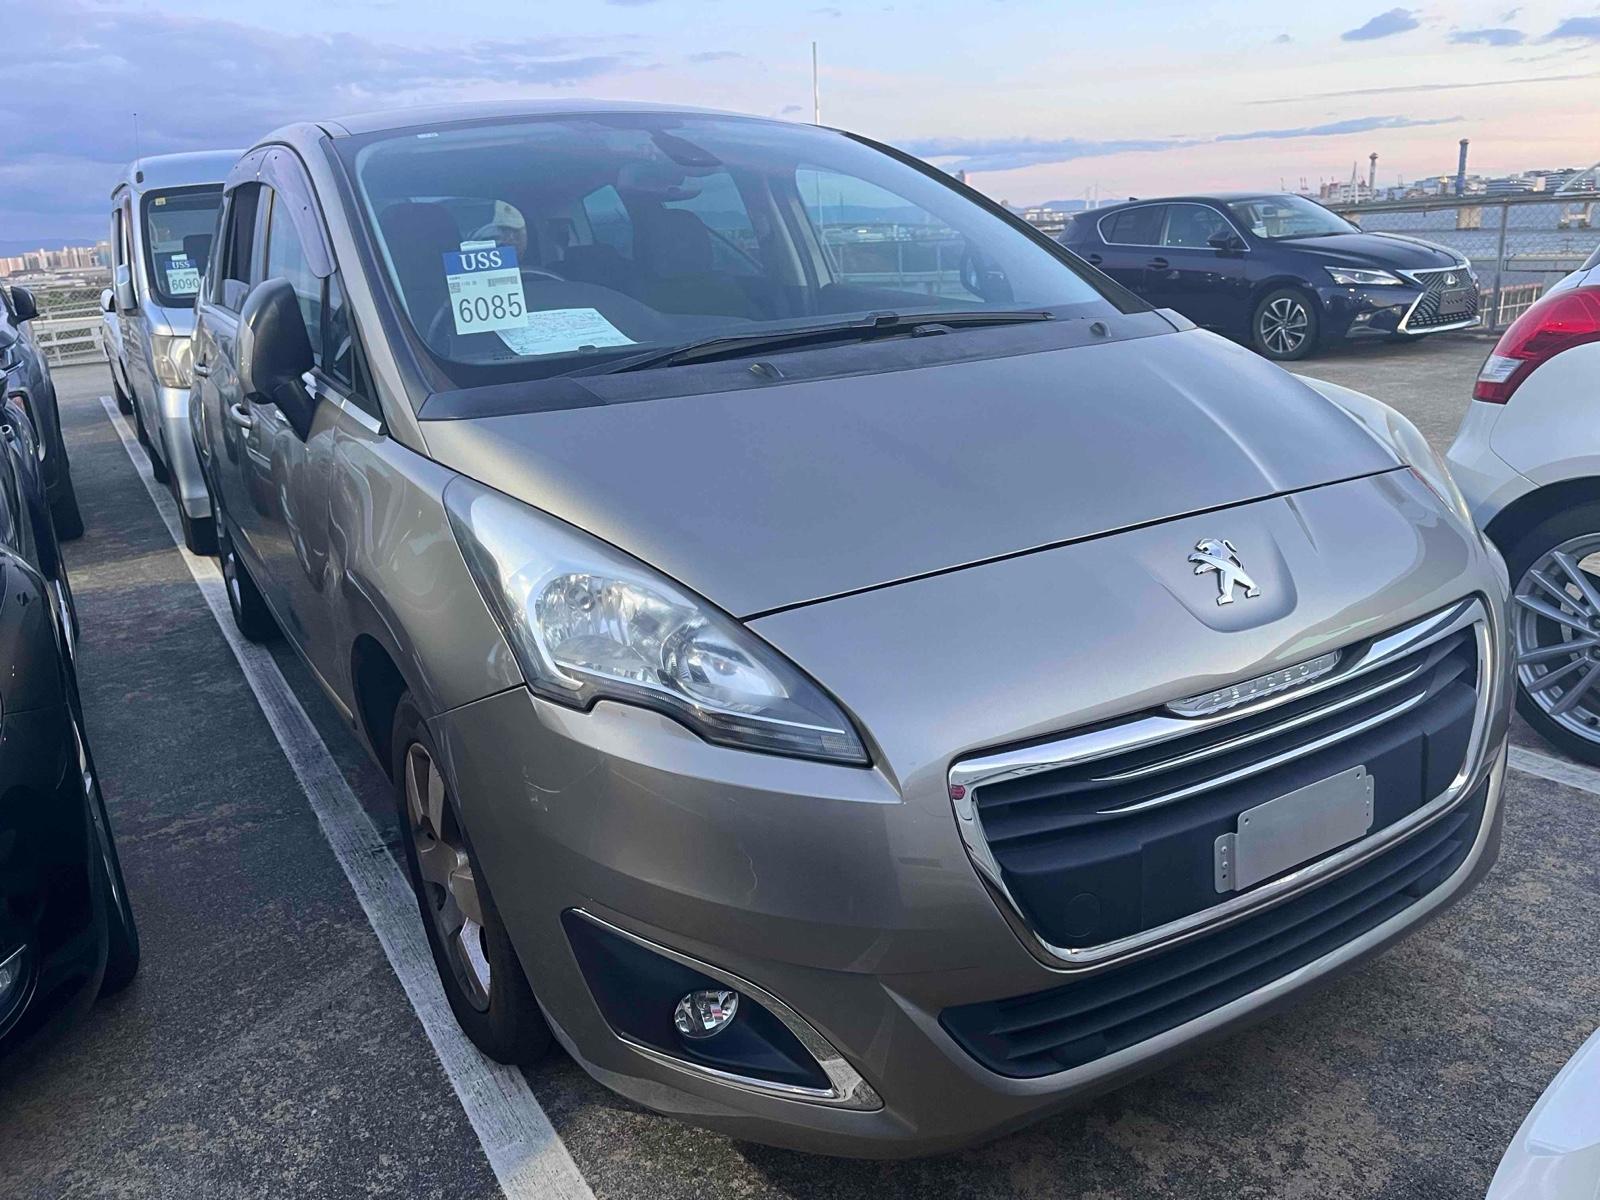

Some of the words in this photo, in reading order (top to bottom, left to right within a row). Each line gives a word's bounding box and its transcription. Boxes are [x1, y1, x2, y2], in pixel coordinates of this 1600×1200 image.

[172, 261, 190, 269] USS
[459, 250, 502, 271] USS
[172, 278, 200, 290] 6090
[459, 293, 522, 323] 6085
